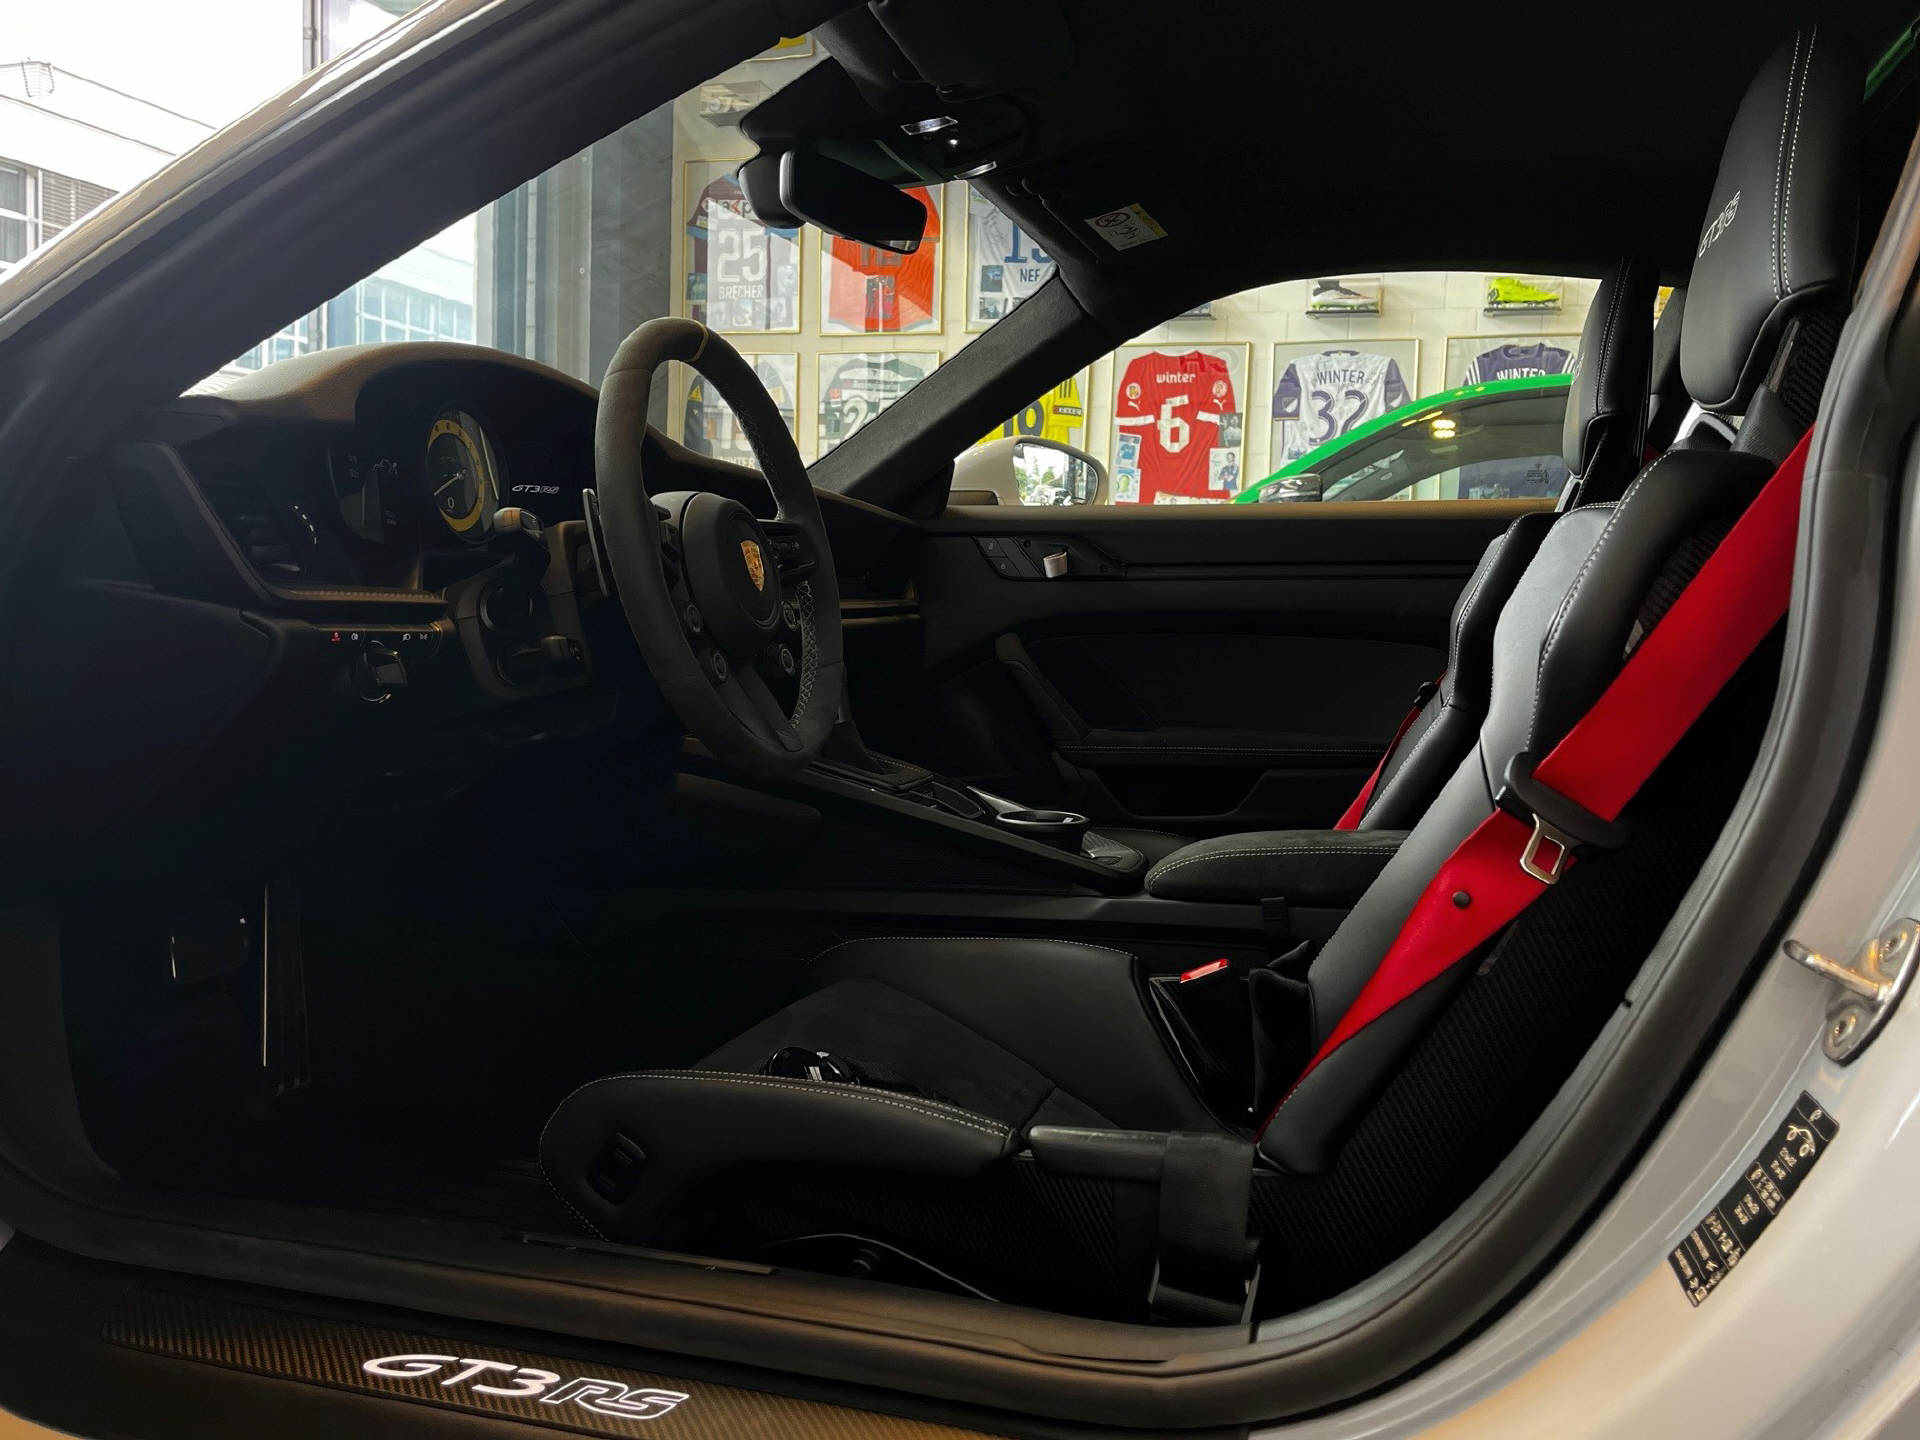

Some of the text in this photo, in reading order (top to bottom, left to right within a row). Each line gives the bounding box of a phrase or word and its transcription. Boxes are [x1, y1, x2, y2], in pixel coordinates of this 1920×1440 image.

[717, 228, 767, 283] 25
[1019, 267, 1041, 283] NEF
[719, 284, 763, 301] BRECHER
[1156, 371, 1196, 384] winter
[1316, 369, 1366, 386] WINTER
[1156, 394, 1190, 453] 6
[1309, 389, 1370, 447] 32
